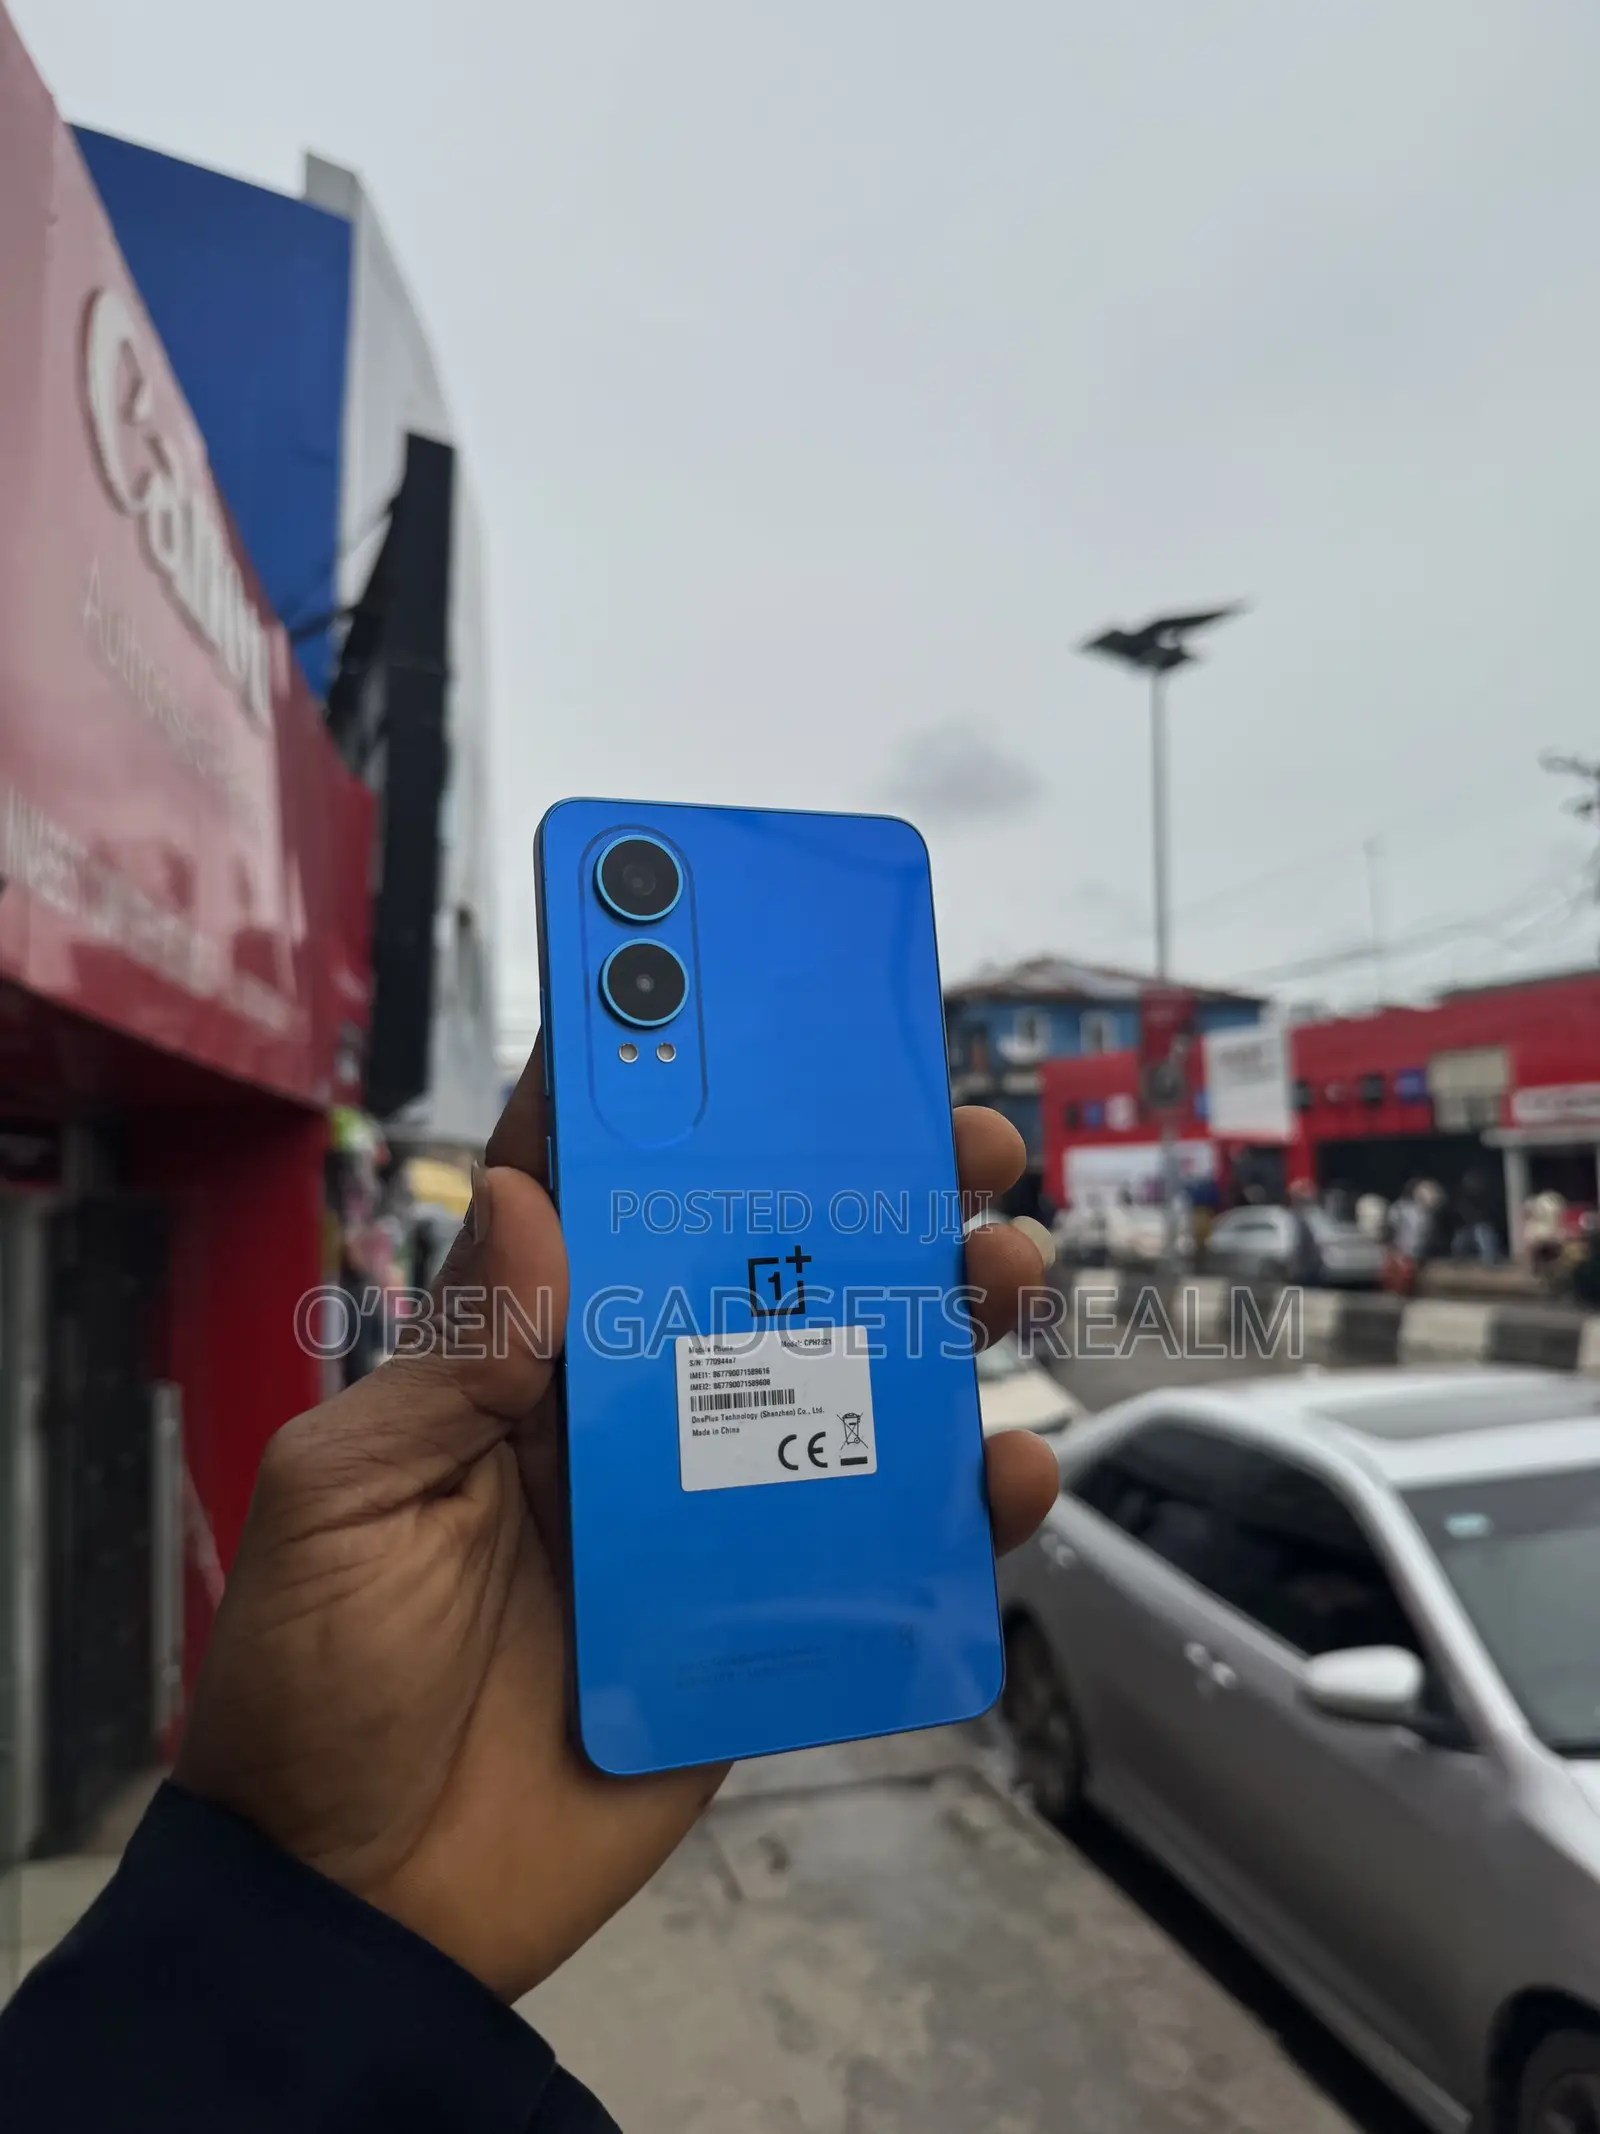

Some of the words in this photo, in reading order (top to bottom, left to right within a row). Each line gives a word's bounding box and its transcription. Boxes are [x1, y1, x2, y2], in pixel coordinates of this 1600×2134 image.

[689, 1371, 712, 1380] IMEI1:
[690, 1383, 712, 1391] IMEI2:
[691, 1415, 719, 1424] OnePlus
[720, 1412, 758, 1421] Technology
[760, 1408, 796, 1419] (Shenzhen)
[812, 1406, 825, 1414] Ltd.
[692, 1428, 710, 1437] Made
[712, 1427, 719, 1435] in
[720, 1426, 740, 1435] China
